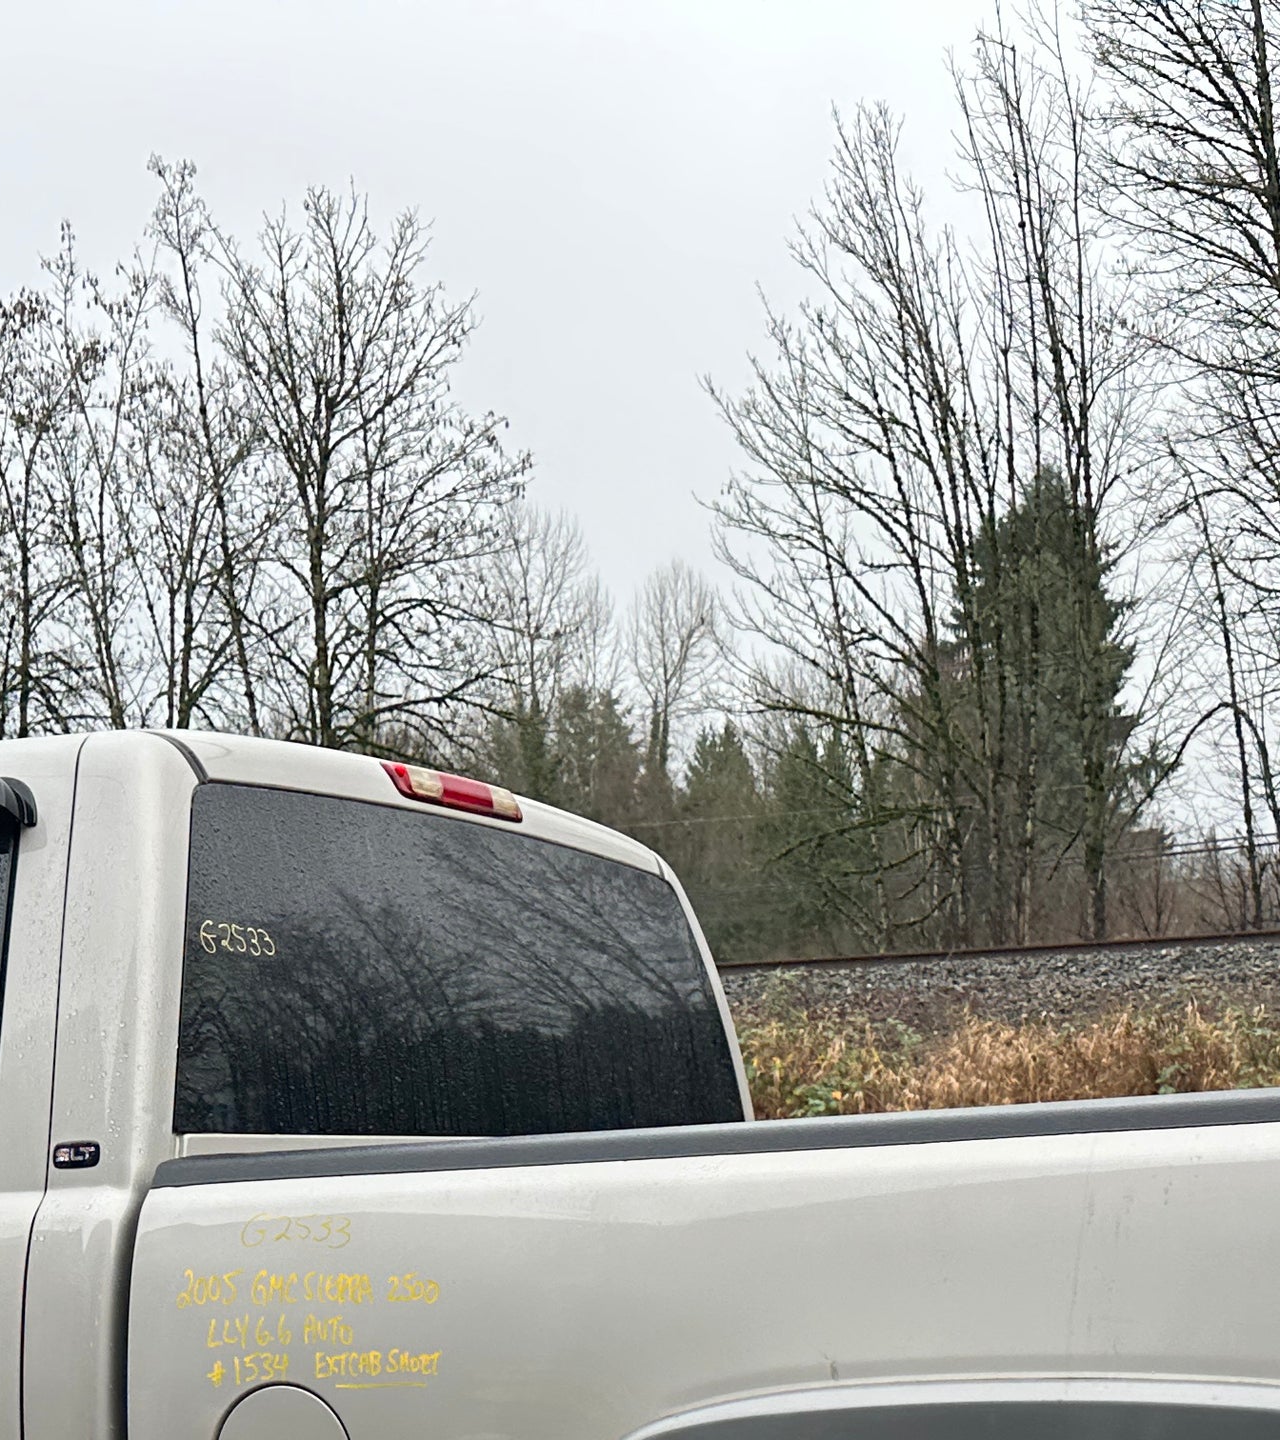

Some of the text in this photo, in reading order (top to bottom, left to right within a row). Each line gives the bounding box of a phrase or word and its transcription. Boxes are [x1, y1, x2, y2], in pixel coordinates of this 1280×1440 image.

[200, 920, 276, 957] G2533
[240, 1212, 353, 1249] G2533
[176, 1268, 244, 1309] 2005
[251, 1269, 298, 1307] GMC
[387, 1271, 440, 1304] 2500
[207, 1312, 250, 1349] LLY
[303, 1313, 354, 1346] AUTO
